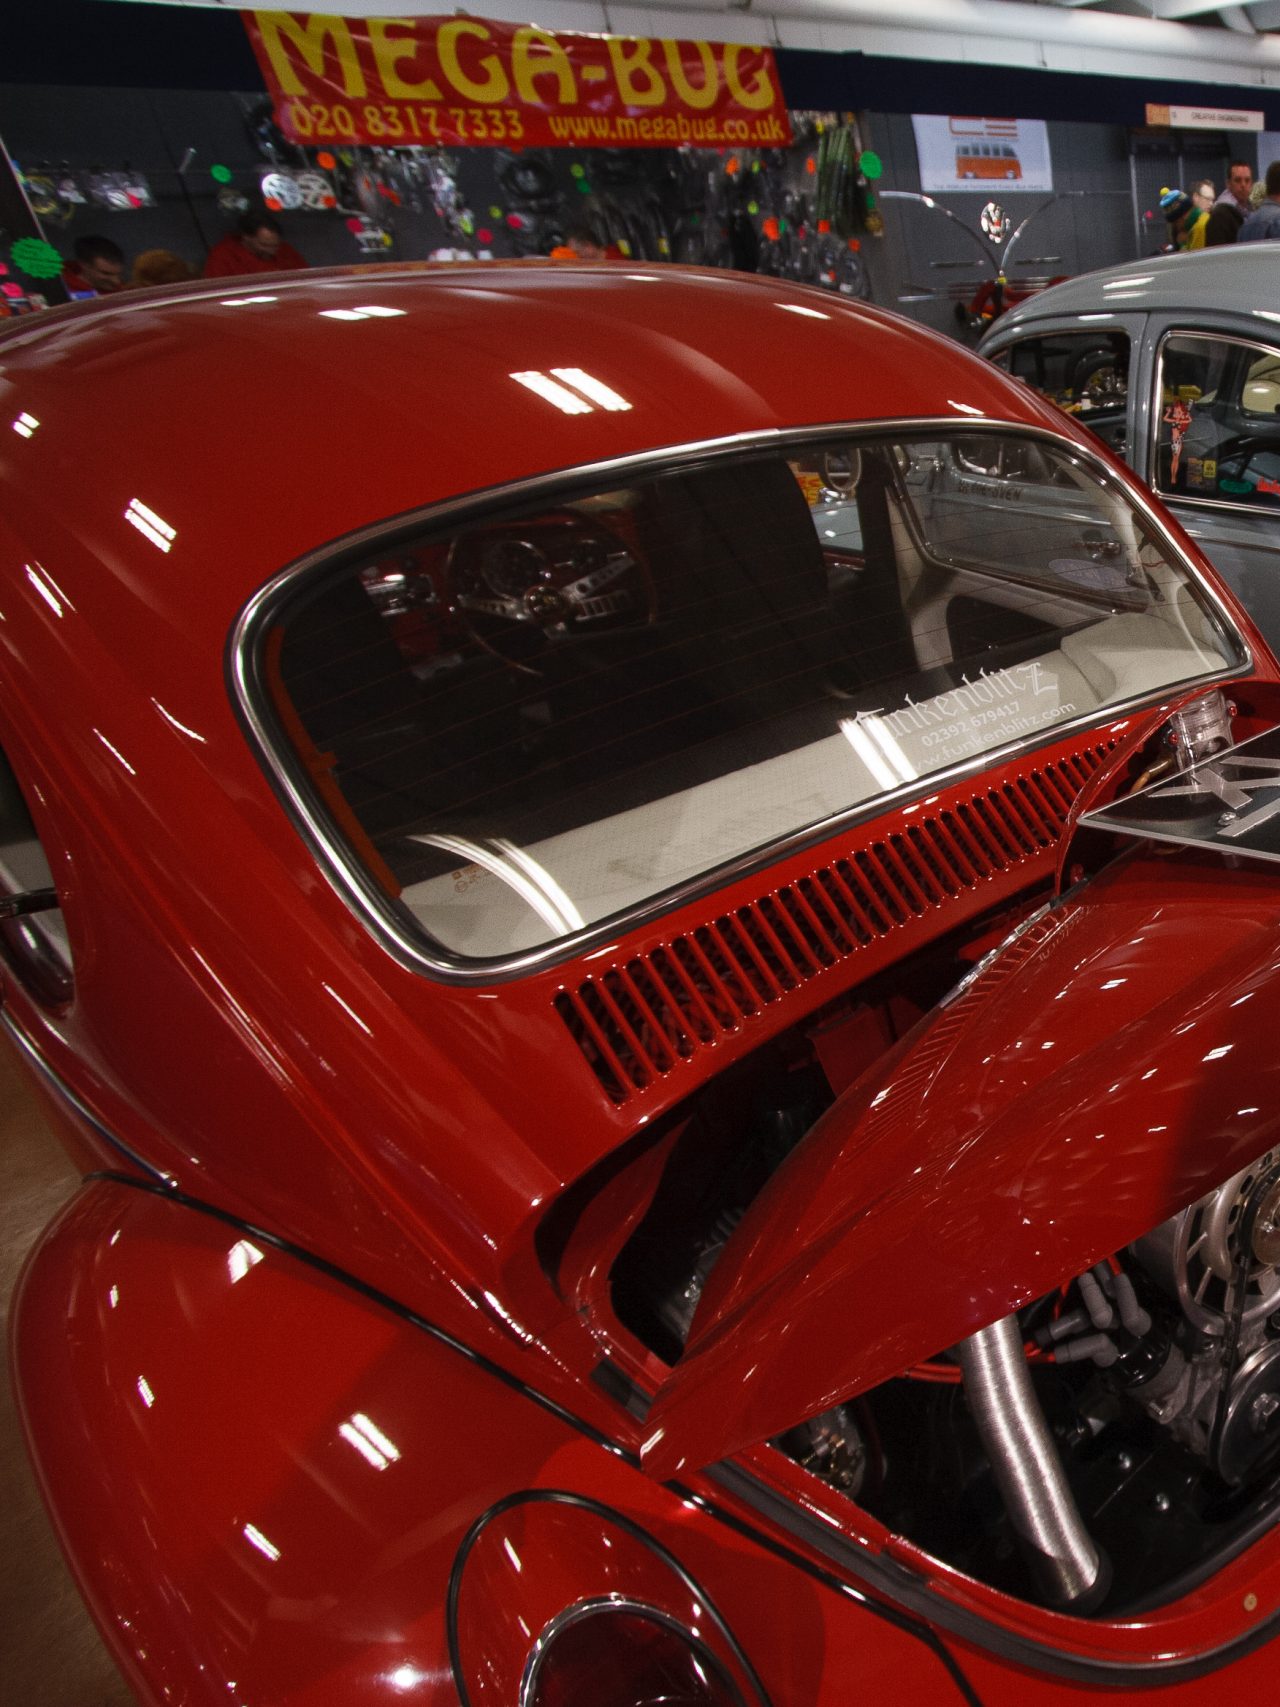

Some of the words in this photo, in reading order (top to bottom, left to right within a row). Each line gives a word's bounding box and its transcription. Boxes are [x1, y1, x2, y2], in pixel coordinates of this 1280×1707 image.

[253, 9, 775, 110] MEGA-BUG
[289, 104, 352, 137] 020
[363, 105, 440, 138] 8317
[450, 107, 525, 140] 7333
[548, 112, 786, 141] www.megabug.co.uk
[921, 721, 972, 747] 02392
[970, 700, 1021, 727] 679417
